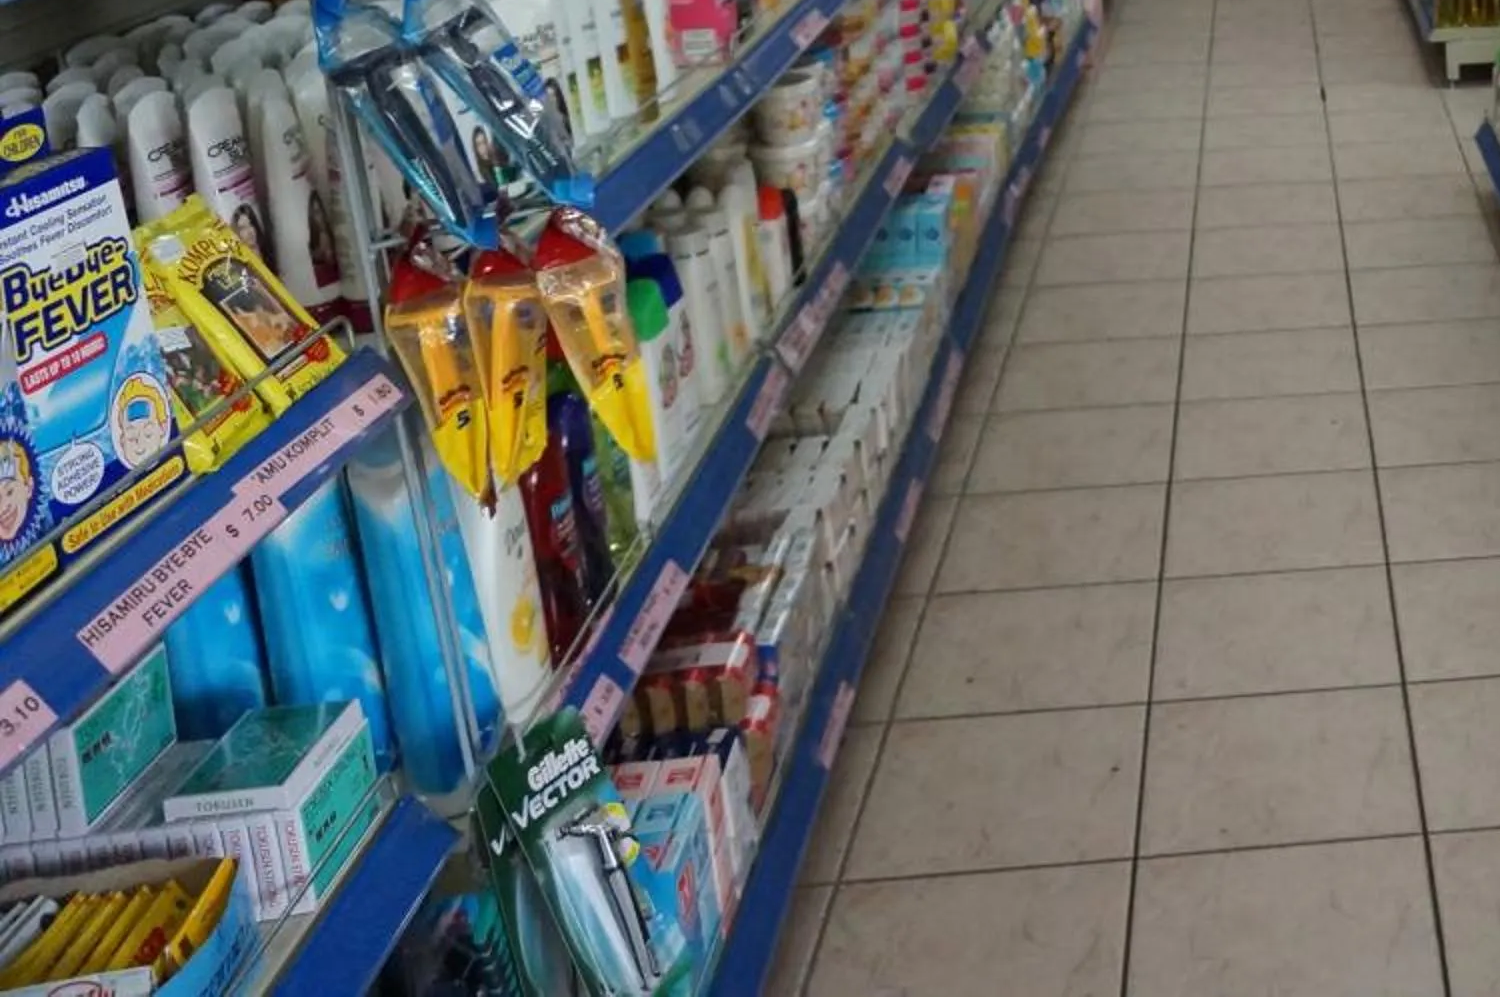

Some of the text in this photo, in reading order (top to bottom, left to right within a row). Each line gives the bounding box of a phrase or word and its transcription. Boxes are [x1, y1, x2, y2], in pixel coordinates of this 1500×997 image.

[5, 175, 86, 218] Hisamitsu
[14, 265, 134, 358] FEVER
[251, 456, 288, 485] AMU
[286, 418, 336, 463] KOMPLIT
[82, 494, 274, 647] HISAMIRU BYE-BYE $ 7.00
[141, 578, 194, 628] FEVER
[0, 695, 40, 737] 3.10
[511, 755, 601, 830] VECTOR
[527, 738, 591, 793] Gillette
